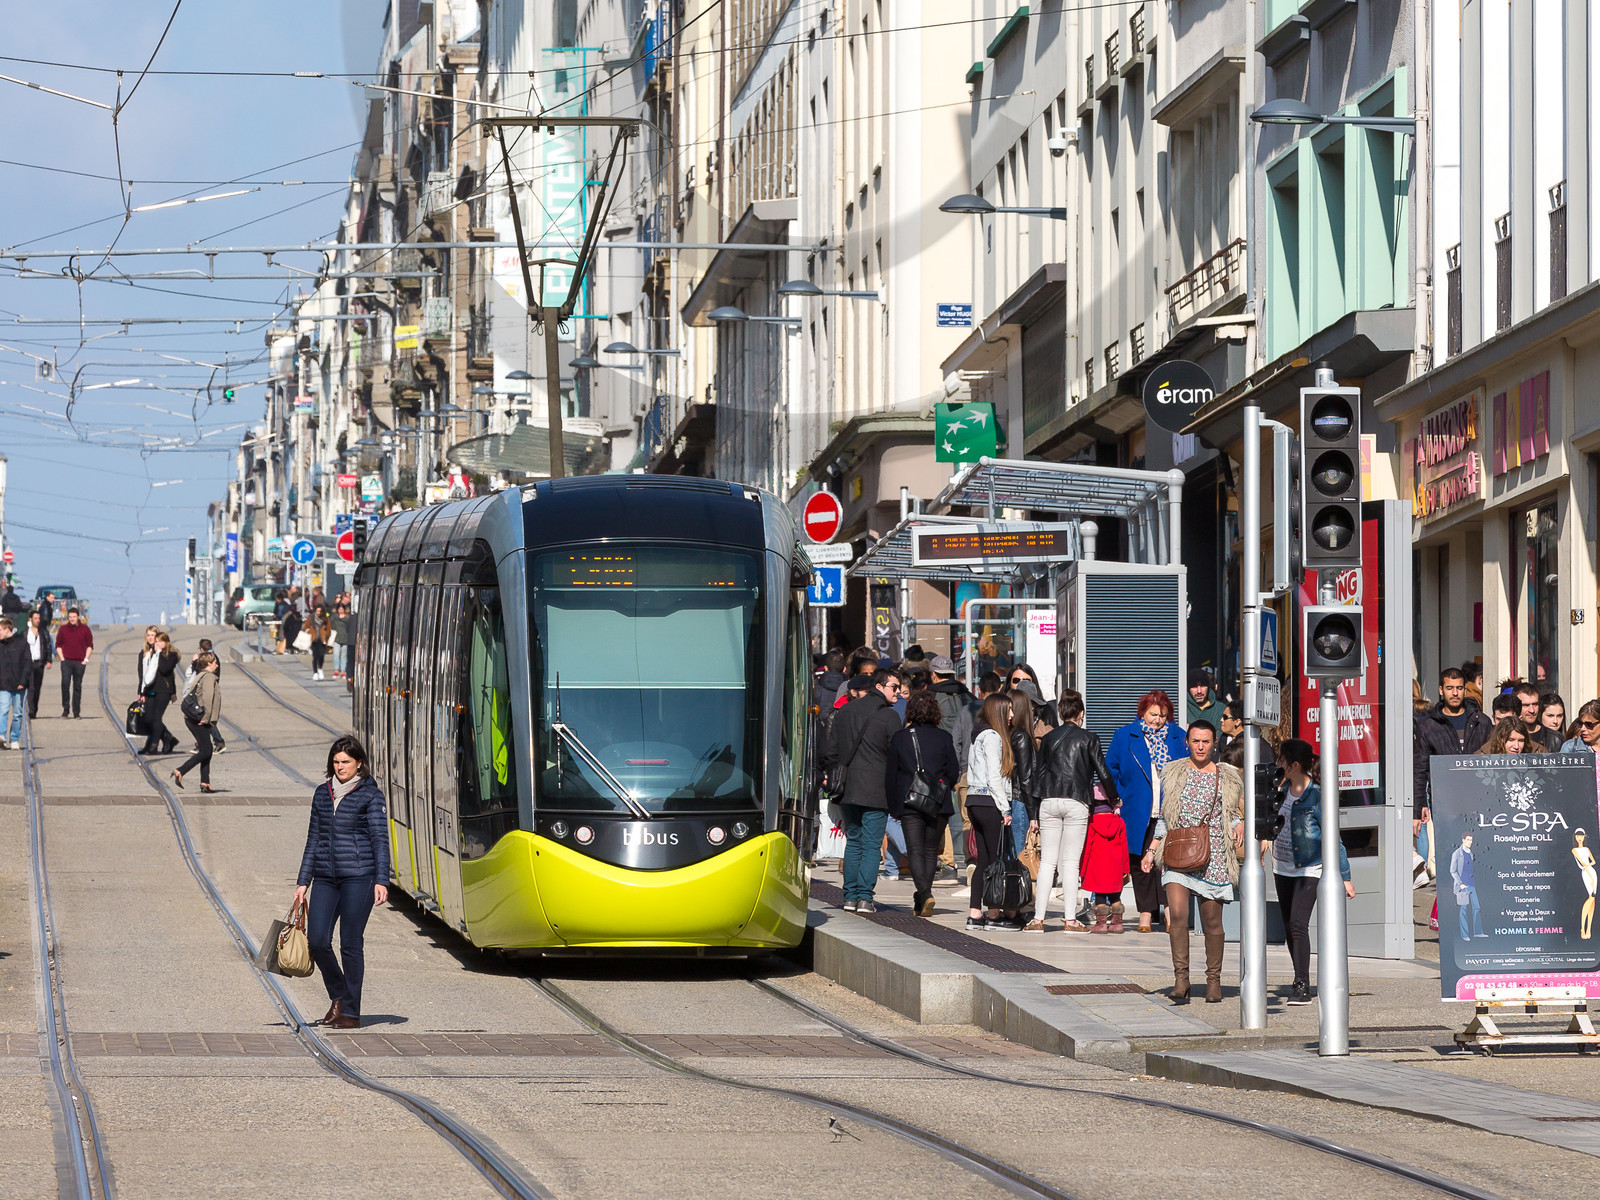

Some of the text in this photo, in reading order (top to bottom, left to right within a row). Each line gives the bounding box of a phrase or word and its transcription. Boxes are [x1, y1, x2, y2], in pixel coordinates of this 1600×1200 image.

[1156, 381, 1213, 404] éram
[1258, 682, 1279, 694] PRIORITÉ
[1256, 710, 1279, 722] TRAMWAY
[1455, 756, 1586, 767] DESTINATION BIEN-ÊTRE
[1478, 812, 1569, 832] LE SPA
[623, 828, 679, 845] bbus
[1494, 833, 1552, 844] Roselyne FOLL
[1503, 884, 1524, 892] Espace
